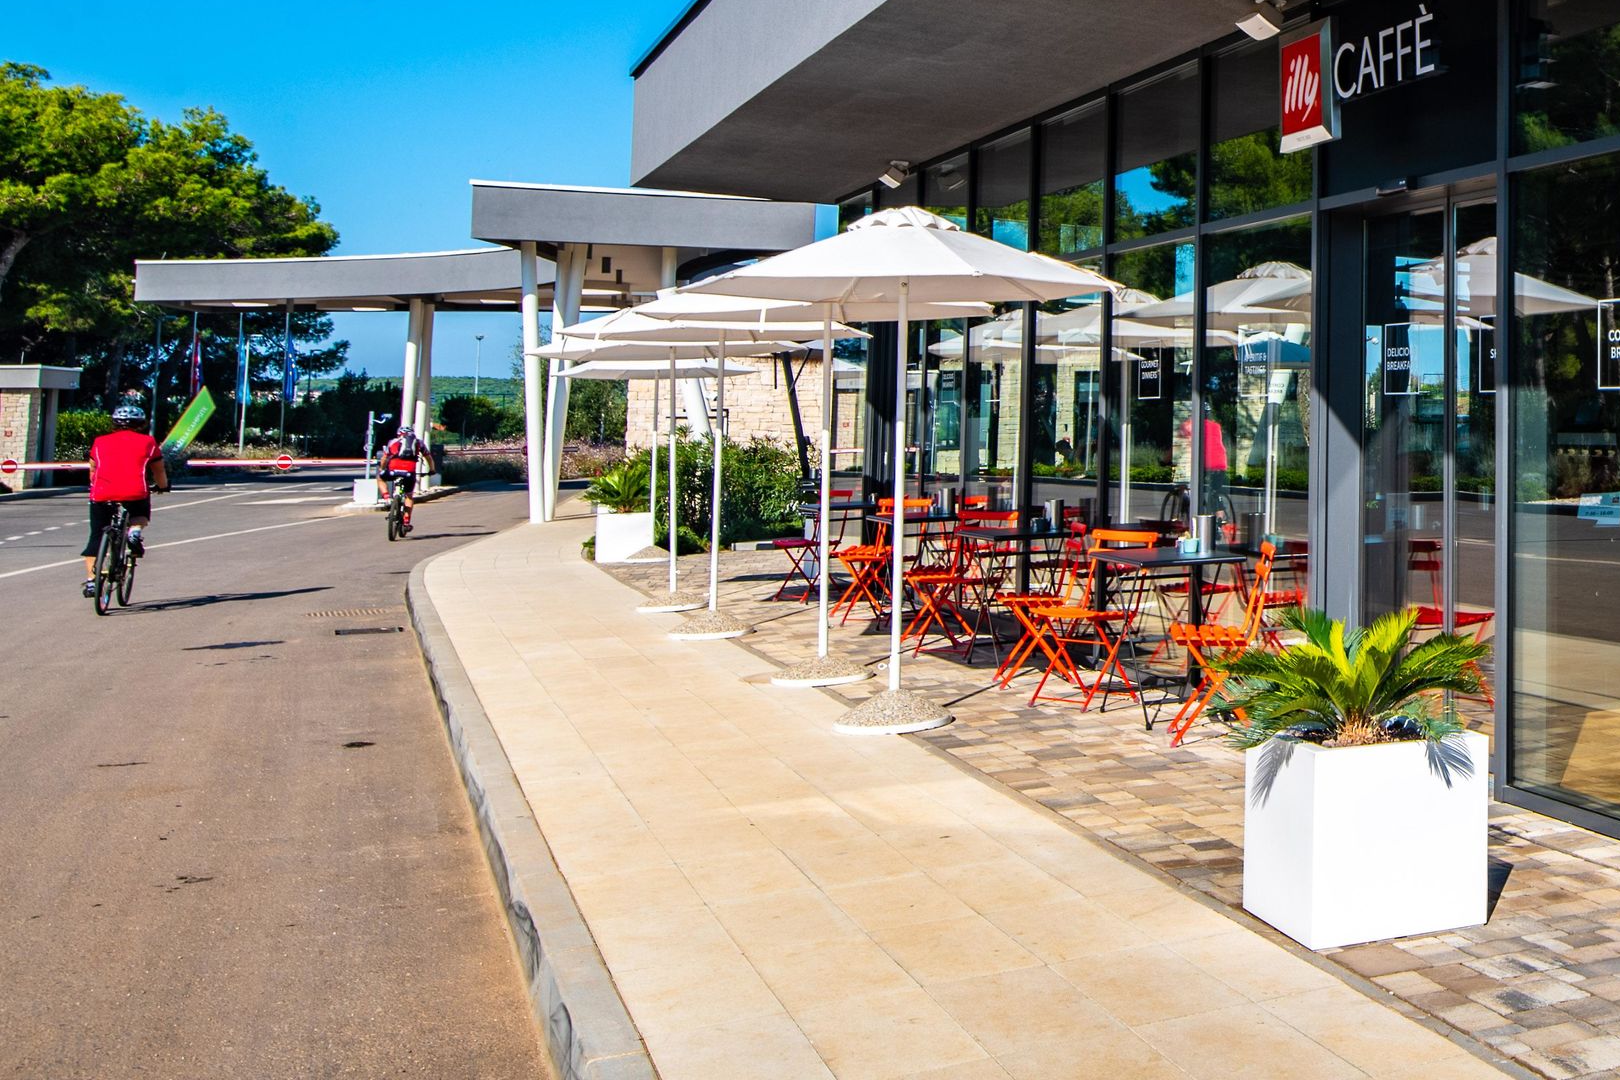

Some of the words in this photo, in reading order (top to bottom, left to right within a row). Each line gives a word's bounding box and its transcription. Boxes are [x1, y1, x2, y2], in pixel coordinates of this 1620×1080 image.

[1284, 53, 1319, 122] illy
[1334, 3, 1435, 99] CAFFÈ
[1387, 347, 1410, 357] DELICIO
[1387, 361, 1411, 371] BREAKFA
